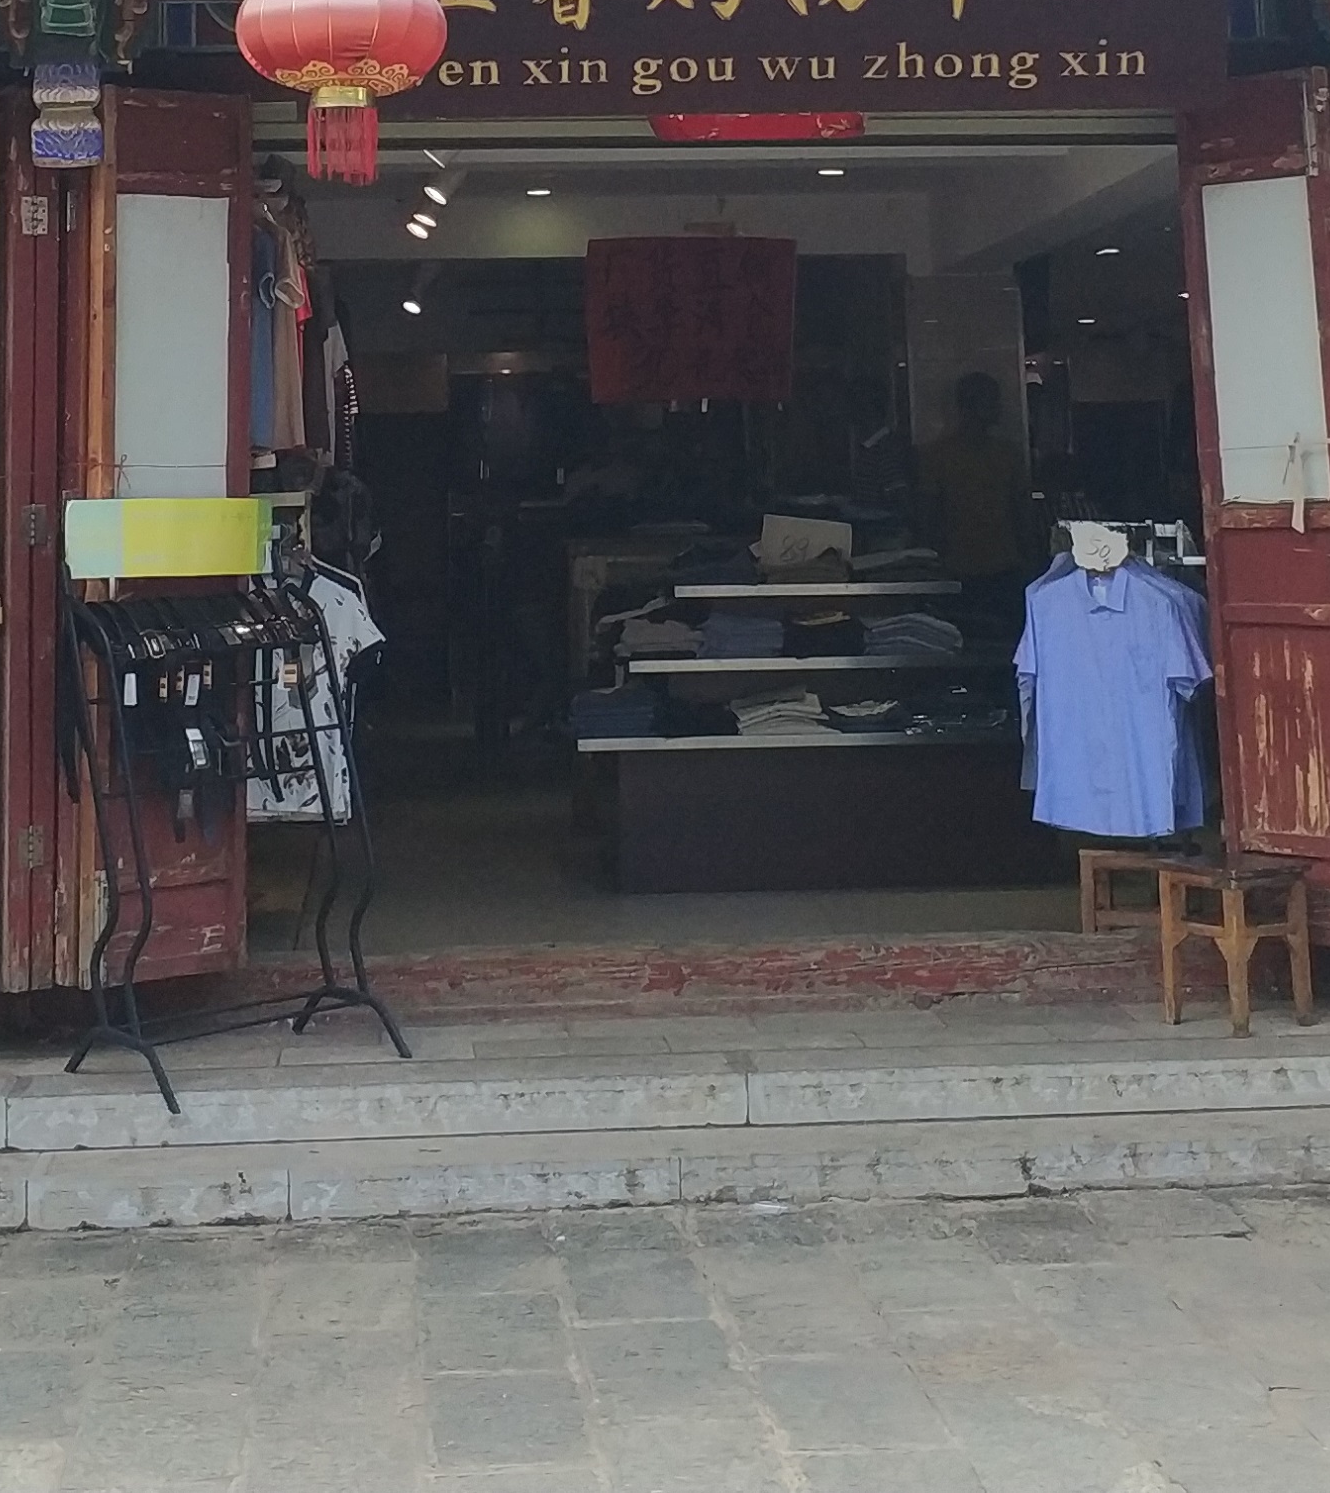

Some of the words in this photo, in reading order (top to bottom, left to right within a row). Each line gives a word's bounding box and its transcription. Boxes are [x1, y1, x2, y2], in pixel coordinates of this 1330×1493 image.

[438, 60, 500, 86] en
[523, 47, 609, 86] xin
[632, 52, 736, 96] gou
[758, 54, 838, 82] wu
[864, 41, 1038, 89] zhong
[1060, 38, 1147, 78] xin
